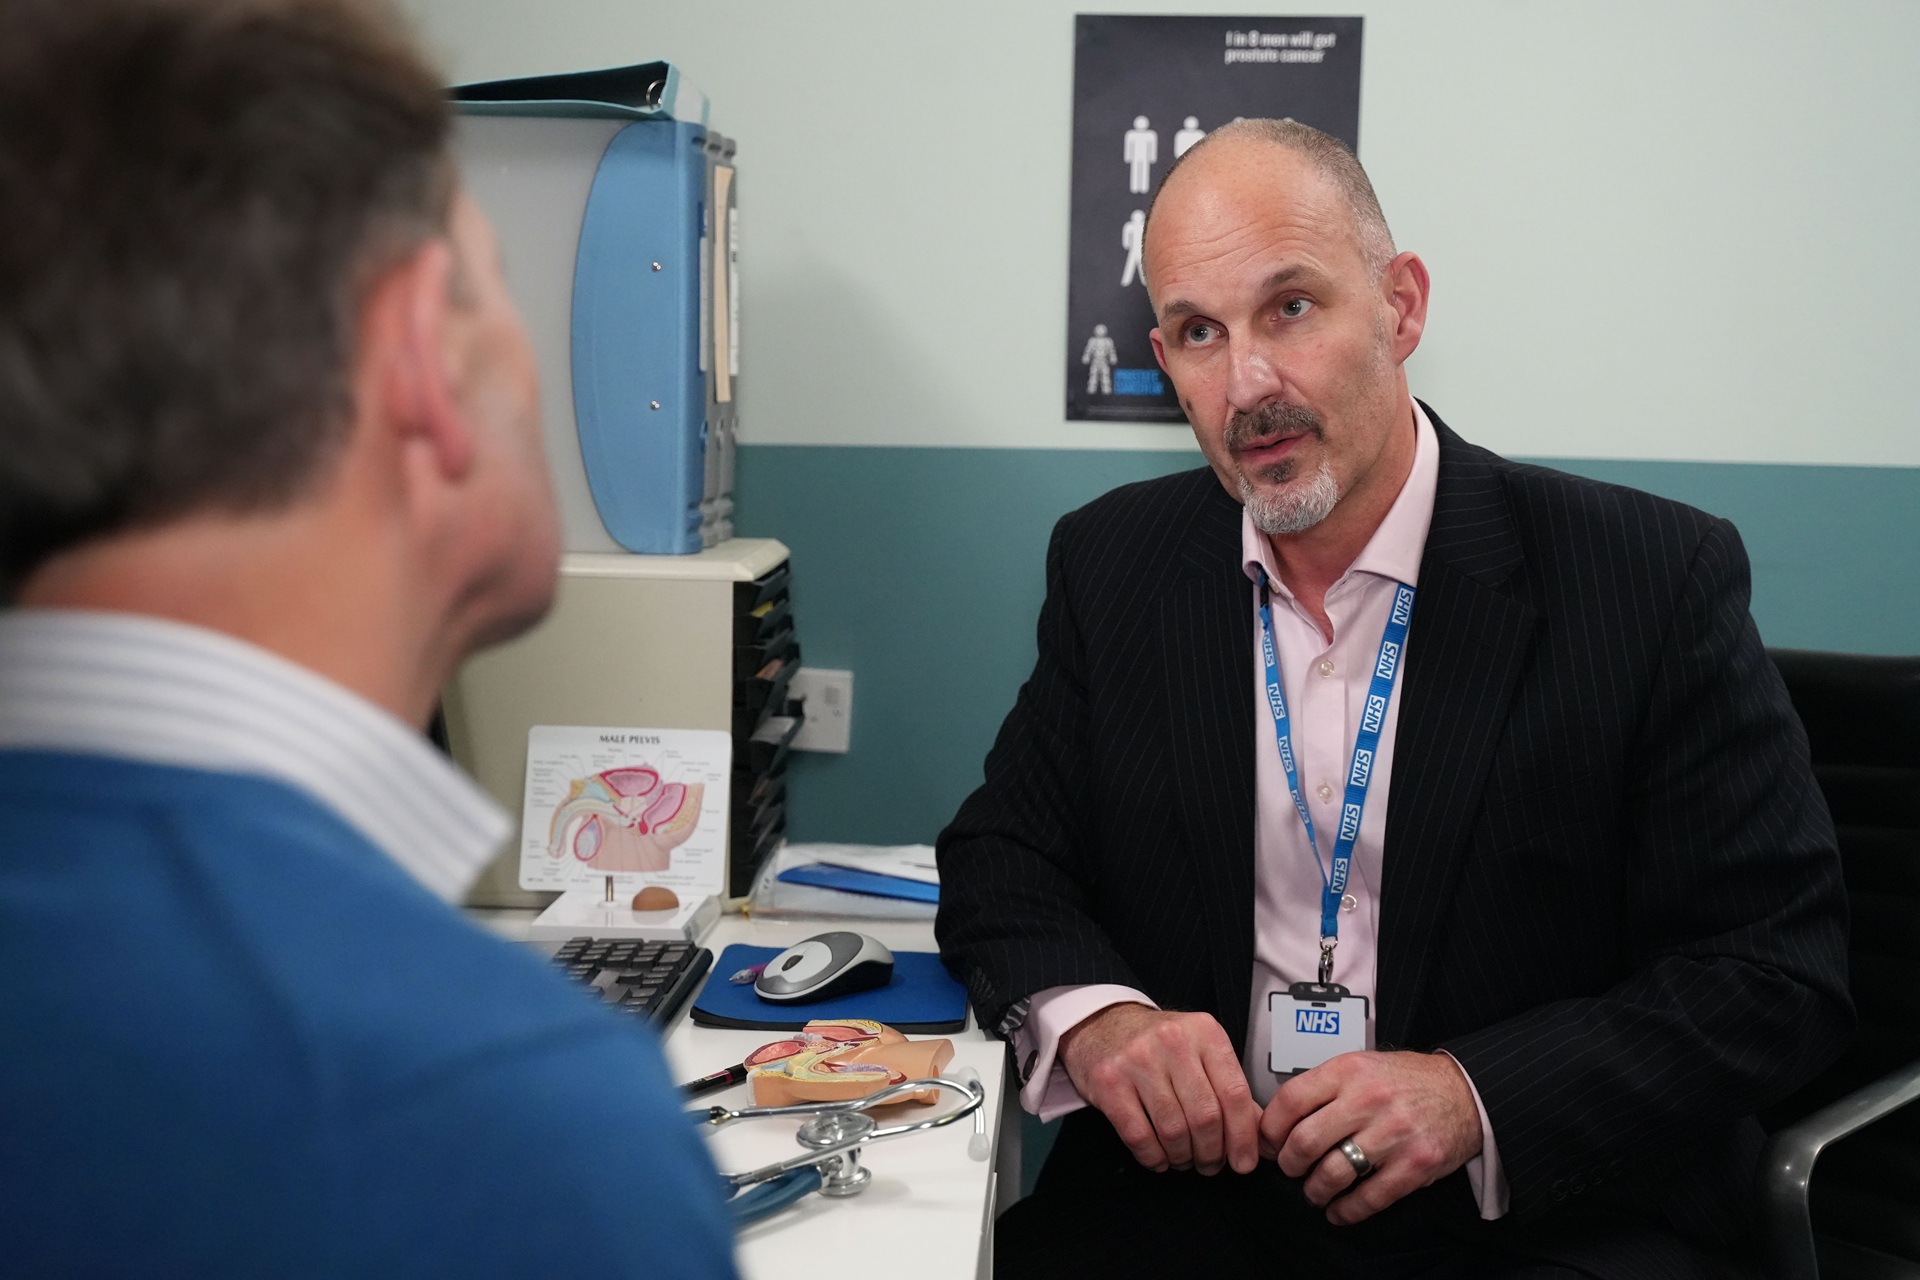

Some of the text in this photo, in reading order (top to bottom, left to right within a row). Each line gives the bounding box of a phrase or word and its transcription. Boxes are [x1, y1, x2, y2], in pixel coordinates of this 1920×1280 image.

[1225, 48, 1326, 64] prostate cancer
[1233, 30, 1248, 47] in
[1248, 30, 1260, 47] 8
[1260, 33, 1289, 47] men
[1290, 31, 1314, 47] will
[1313, 32, 1337, 50] get
[1394, 589, 1413, 625] NHS
[1263, 631, 1275, 665] NHS
[1378, 643, 1398, 678] NHS
[1268, 685, 1285, 718] NHS
[1364, 696, 1384, 732] NHS
[599, 735, 661, 745] MALE PELVIS
[1279, 738, 1293, 771] NHS
[1352, 750, 1371, 786] NHS
[1342, 805, 1359, 840] NHS
[1332, 859, 1347, 892] NHS
[1297, 1010, 1339, 1033] NHS
